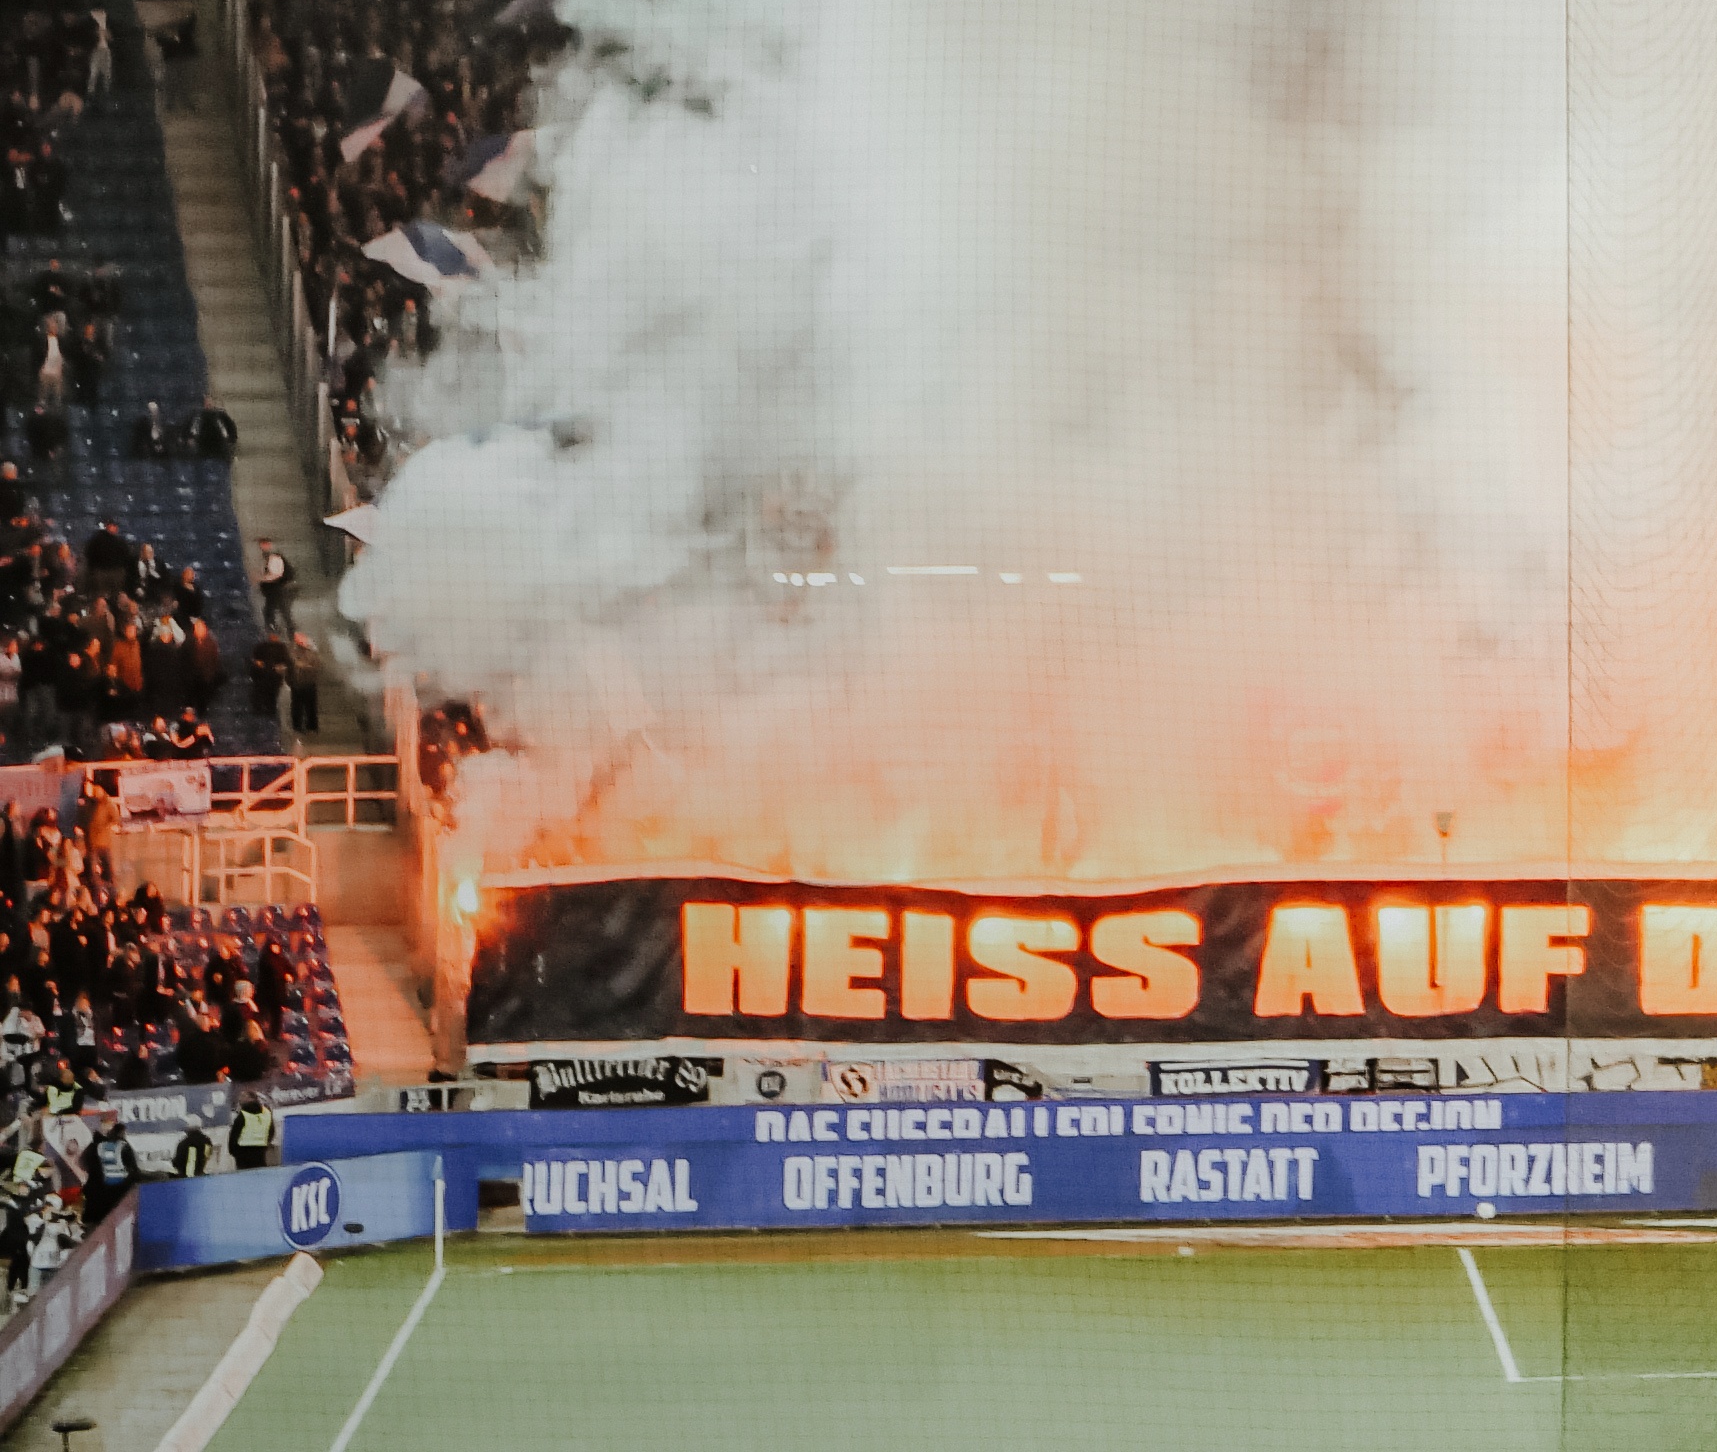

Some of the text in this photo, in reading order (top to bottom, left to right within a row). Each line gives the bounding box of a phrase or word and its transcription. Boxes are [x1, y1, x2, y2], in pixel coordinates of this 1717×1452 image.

[680, 901, 1202, 1020] HEISS
[1252, 903, 1591, 1018] AUF
[783, 1152, 1033, 1210] OFFENBURG
[1139, 1146, 1320, 1204] RASTATT
[1417, 1142, 1653, 1198] PFORZHEIM
[291, 1177, 332, 1234] KSC
